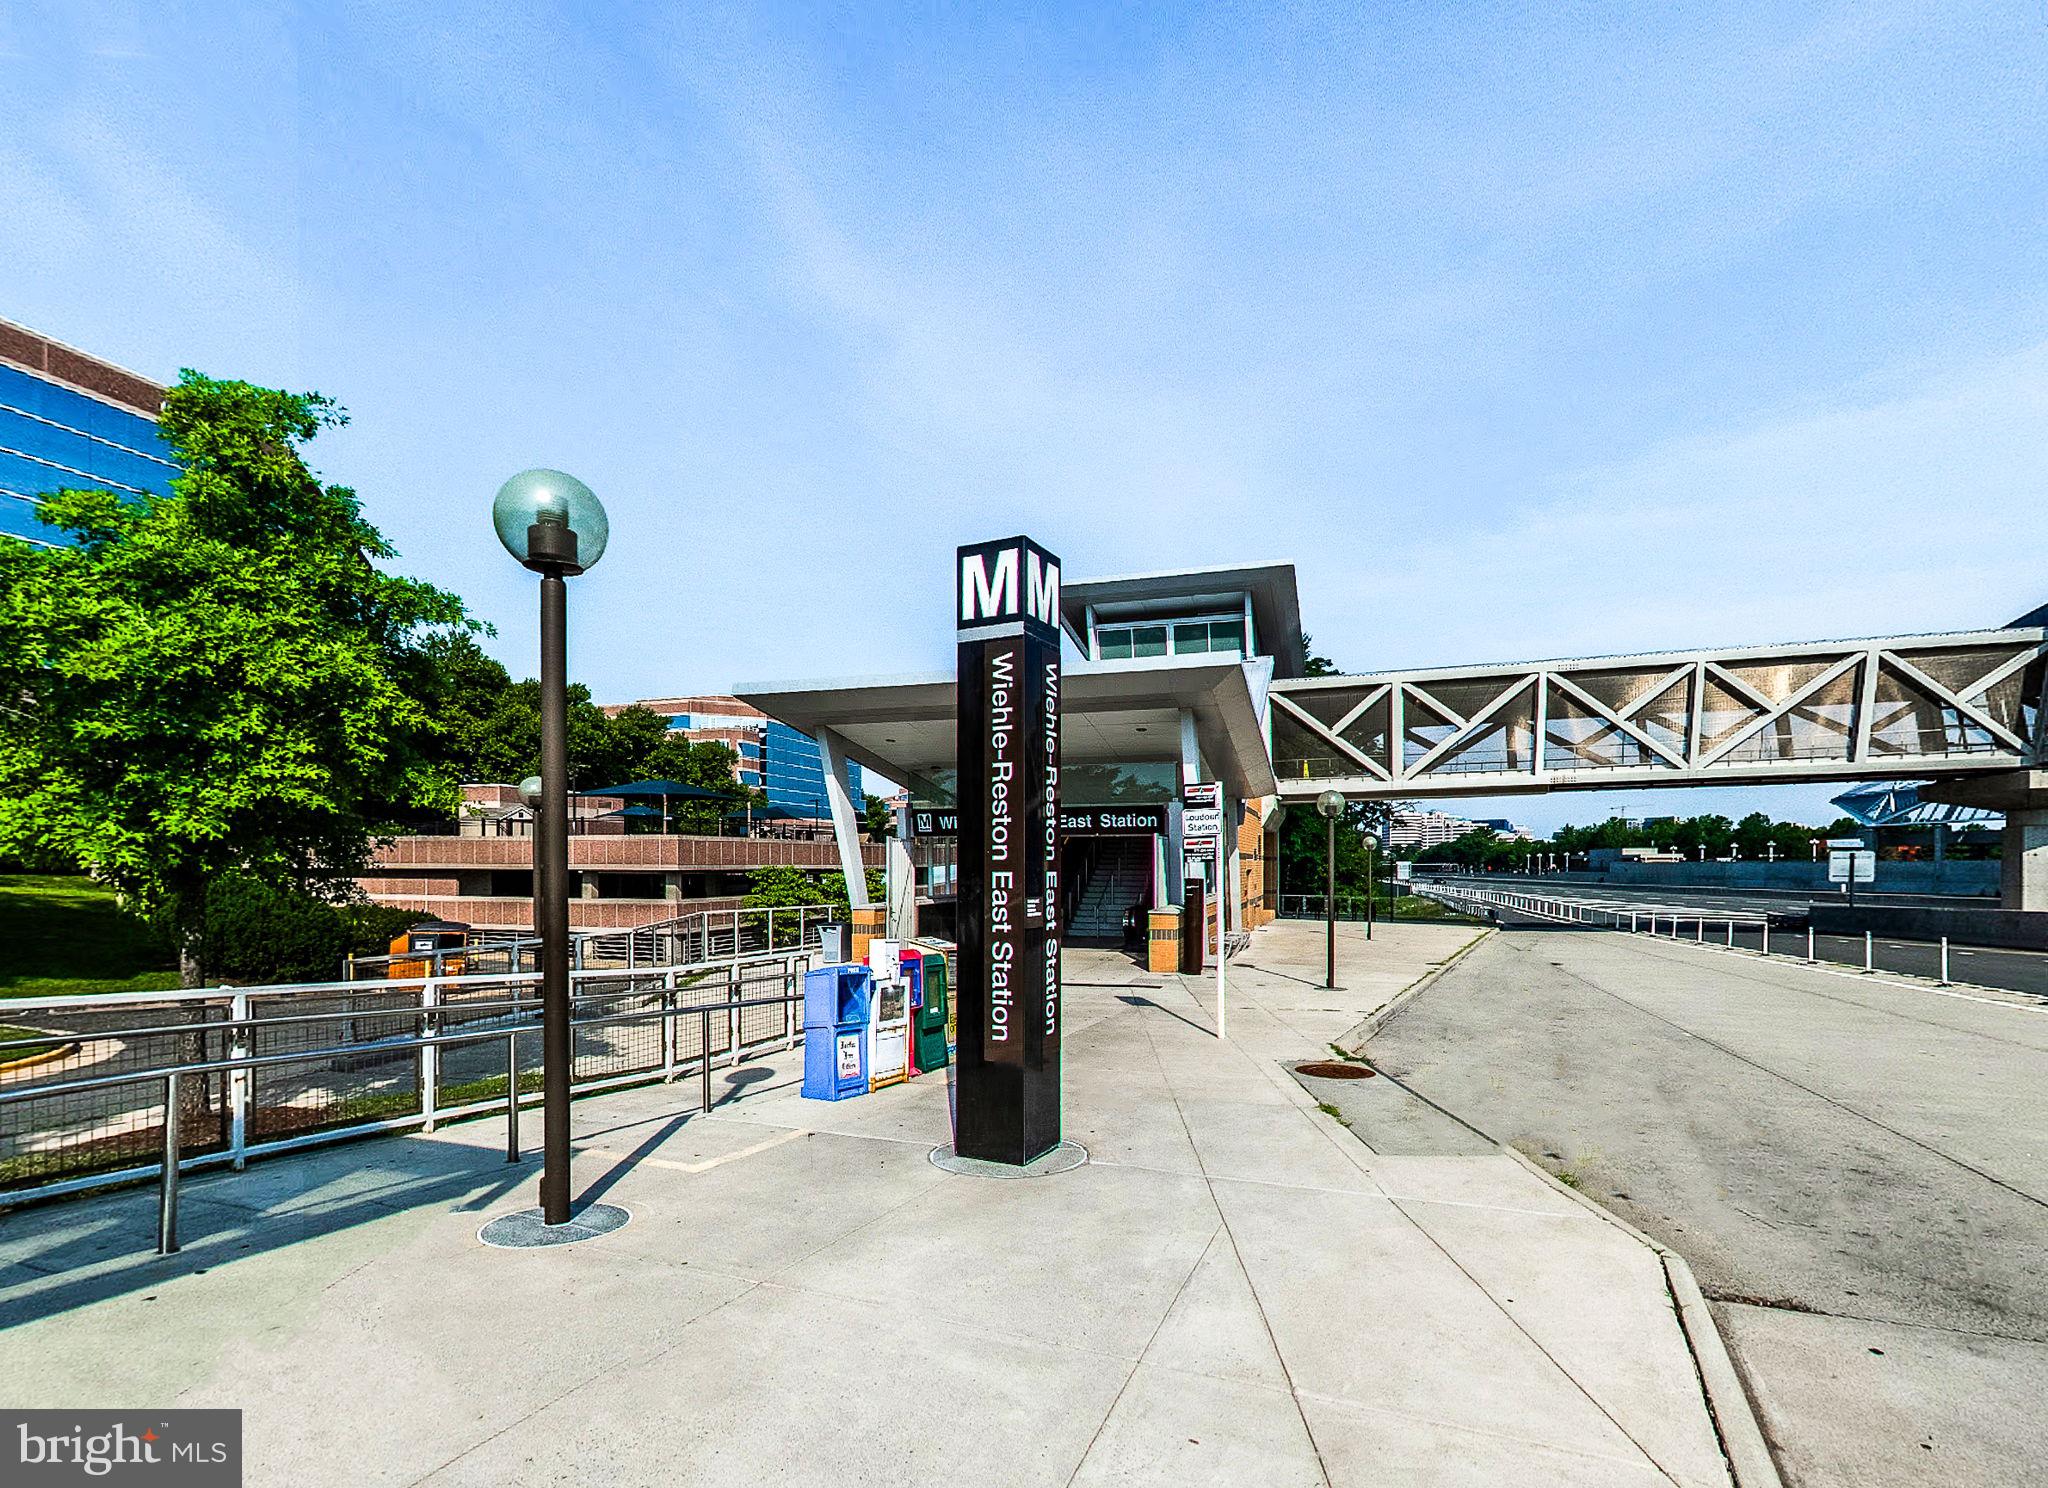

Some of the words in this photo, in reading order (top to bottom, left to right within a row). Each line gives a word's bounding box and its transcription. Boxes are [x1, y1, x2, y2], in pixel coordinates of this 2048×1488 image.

[962, 548, 1018, 620] M
[1027, 549, 1059, 629] M
[992, 652, 1013, 860] Wiehle-Reston
[1046, 663, 1058, 860] Wiehle-Reston
[939, 815, 958, 829] Wi
[1060, 814, 1092, 828] East
[1100, 813, 1158, 828] Station
[1188, 823, 1218, 832] Station
[992, 871, 1013, 933] East
[1046, 871, 1058, 931] East
[992, 941, 1013, 1041] Station
[1046, 938, 1058, 1035] Station
